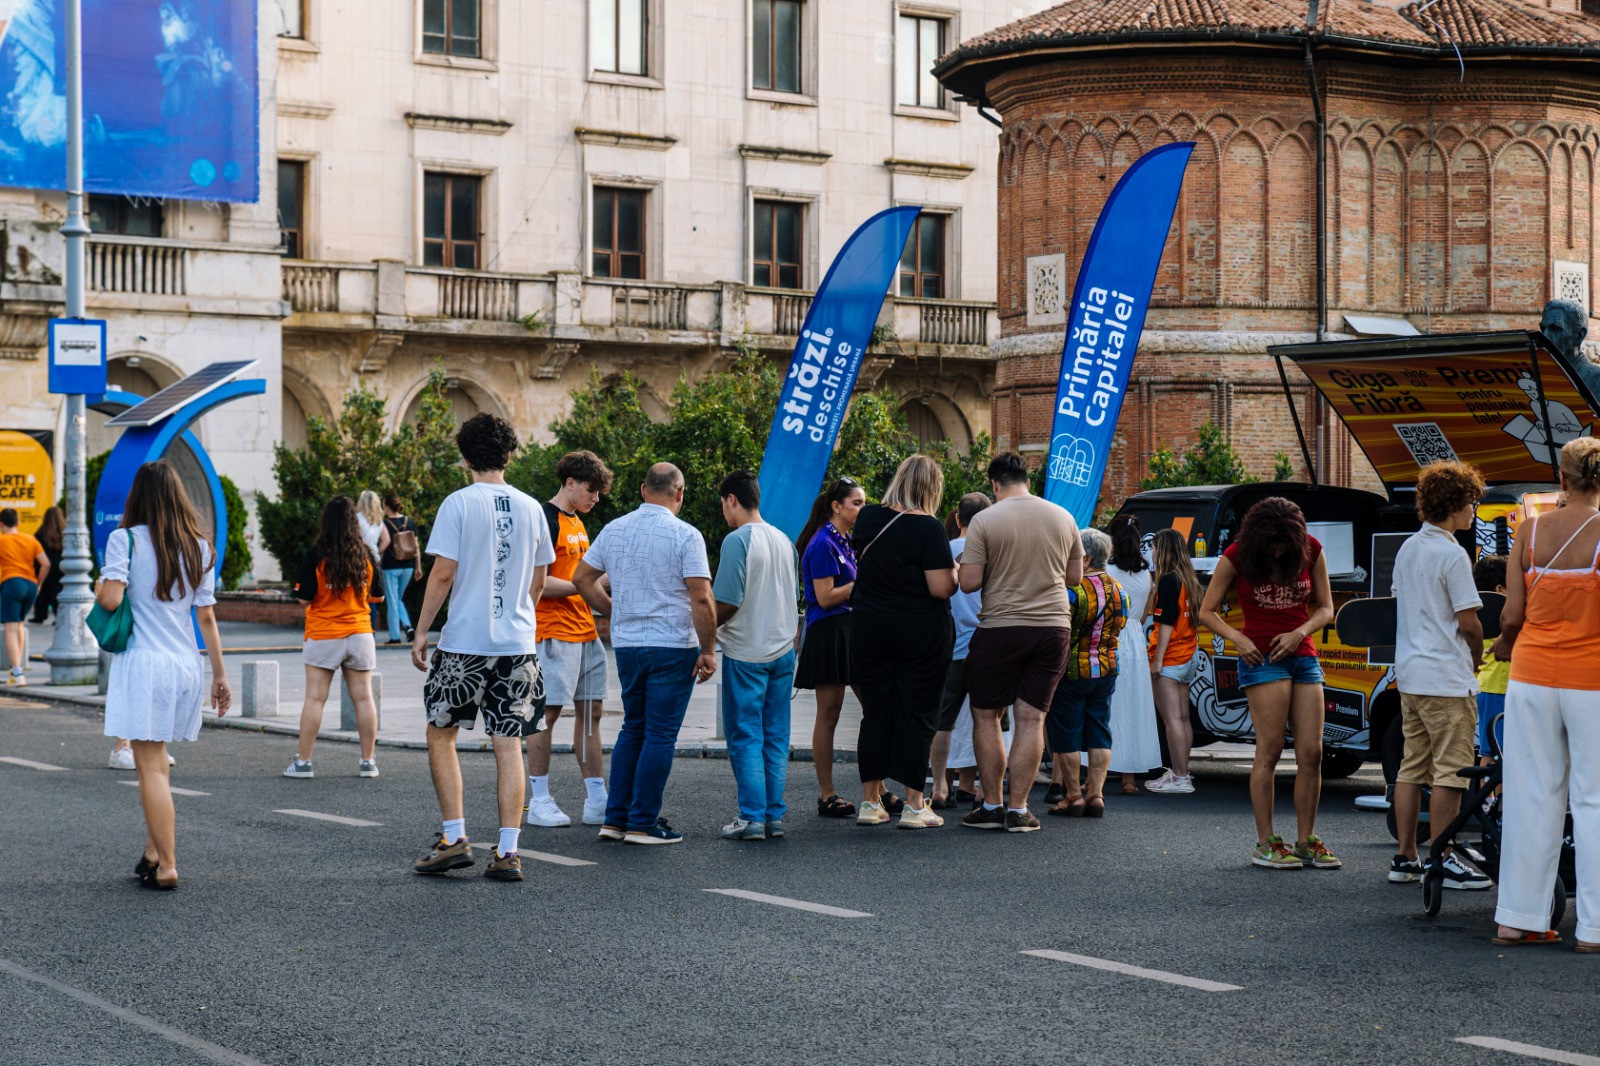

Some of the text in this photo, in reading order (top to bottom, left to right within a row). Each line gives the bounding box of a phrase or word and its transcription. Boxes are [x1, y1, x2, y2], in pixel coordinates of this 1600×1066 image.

[1058, 286, 1108, 419] Primăria
[1085, 289, 1135, 427] Capitalei
[1327, 368, 1400, 393] Giga
[1400, 368, 1429, 379] vine
[1410, 379, 1428, 388] cu
[807, 341, 852, 443] deschise
[1456, 388, 1503, 401] pentru
[1345, 389, 1426, 415] Fibră
[1465, 398, 1527, 413] pasiunile
[1473, 411, 1506, 424] tale!
[1324, 649, 1341, 660] rapid
[1343, 649, 1368, 660] interne
[1335, 661, 1367, 671] pasiunile
[1335, 702, 1359, 716] Premium
